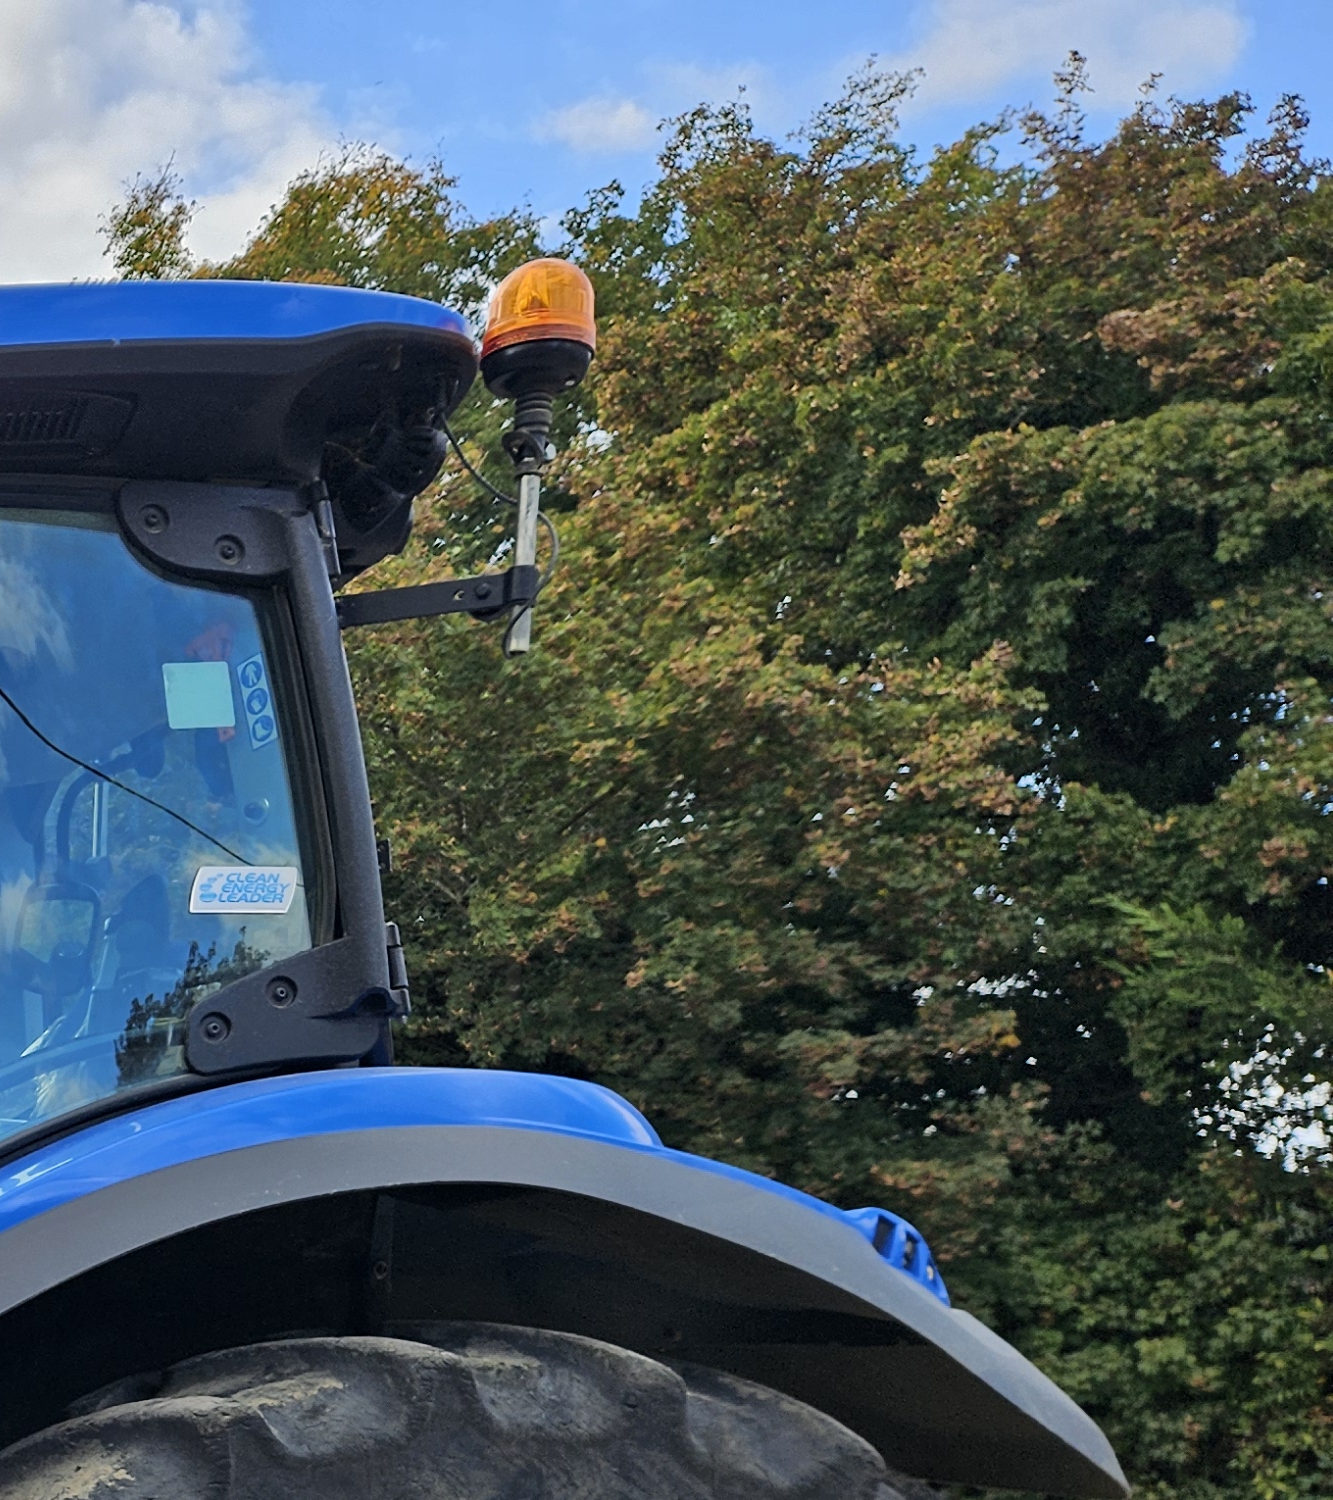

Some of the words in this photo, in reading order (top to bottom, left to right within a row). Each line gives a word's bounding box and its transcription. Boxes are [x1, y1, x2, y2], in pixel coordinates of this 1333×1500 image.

[226, 872, 280, 883] CLEAN
[221, 882, 290, 893] ENERGY
[218, 893, 285, 903] LEADER
